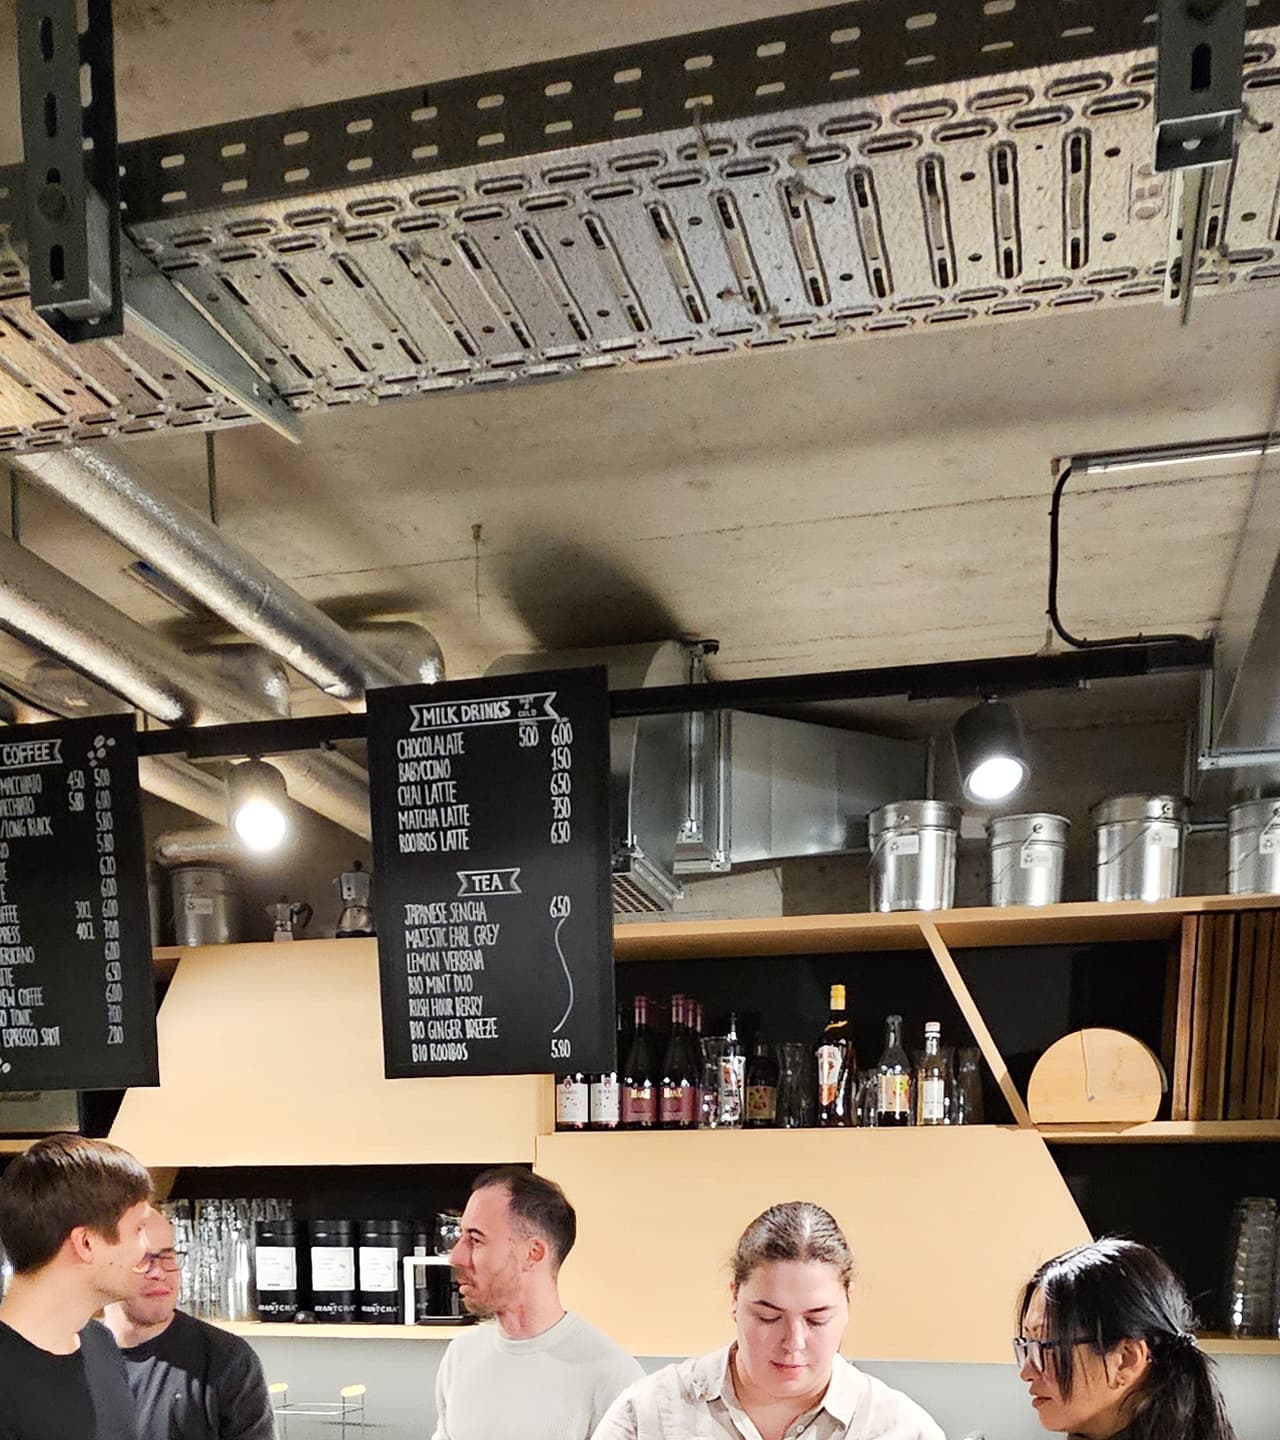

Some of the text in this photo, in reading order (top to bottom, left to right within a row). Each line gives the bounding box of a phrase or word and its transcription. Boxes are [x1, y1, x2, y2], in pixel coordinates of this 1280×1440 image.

[422, 706, 460, 726] MILK
[460, 701, 512, 723] DRINKS
[3, 743, 51, 766] COFFEE
[398, 758, 451, 783] BABYCCINO
[397, 785, 422, 807] CHAI
[424, 781, 457, 805] LATTE
[398, 807, 439, 831] MATCHA
[440, 804, 471, 828] LATTE
[398, 831, 437, 854] ROOIBOS
[440, 828, 470, 852] LATTE
[471, 873, 505, 892] TEA
[404, 902, 448, 926] JAPANESE
[449, 901, 488, 924] SENCHA
[405, 924, 500, 949] MAJESTIC EARL GREY
[406, 949, 485, 974] LEMON VERBENA
[407, 973, 473, 995] BIO MINT DUO
[18, 986, 44, 1007] COFFEE
[408, 995, 483, 1018] RUSH HOUR BERRY
[2, 1027, 39, 1048] ESPRESSO
[40, 1026, 61, 1046] SHOT
[409, 1016, 499, 1040] BIO GINGER BREEZE
[411, 1043, 427, 1063] BIO
[429, 1041, 469, 1062] ROOIBOS
